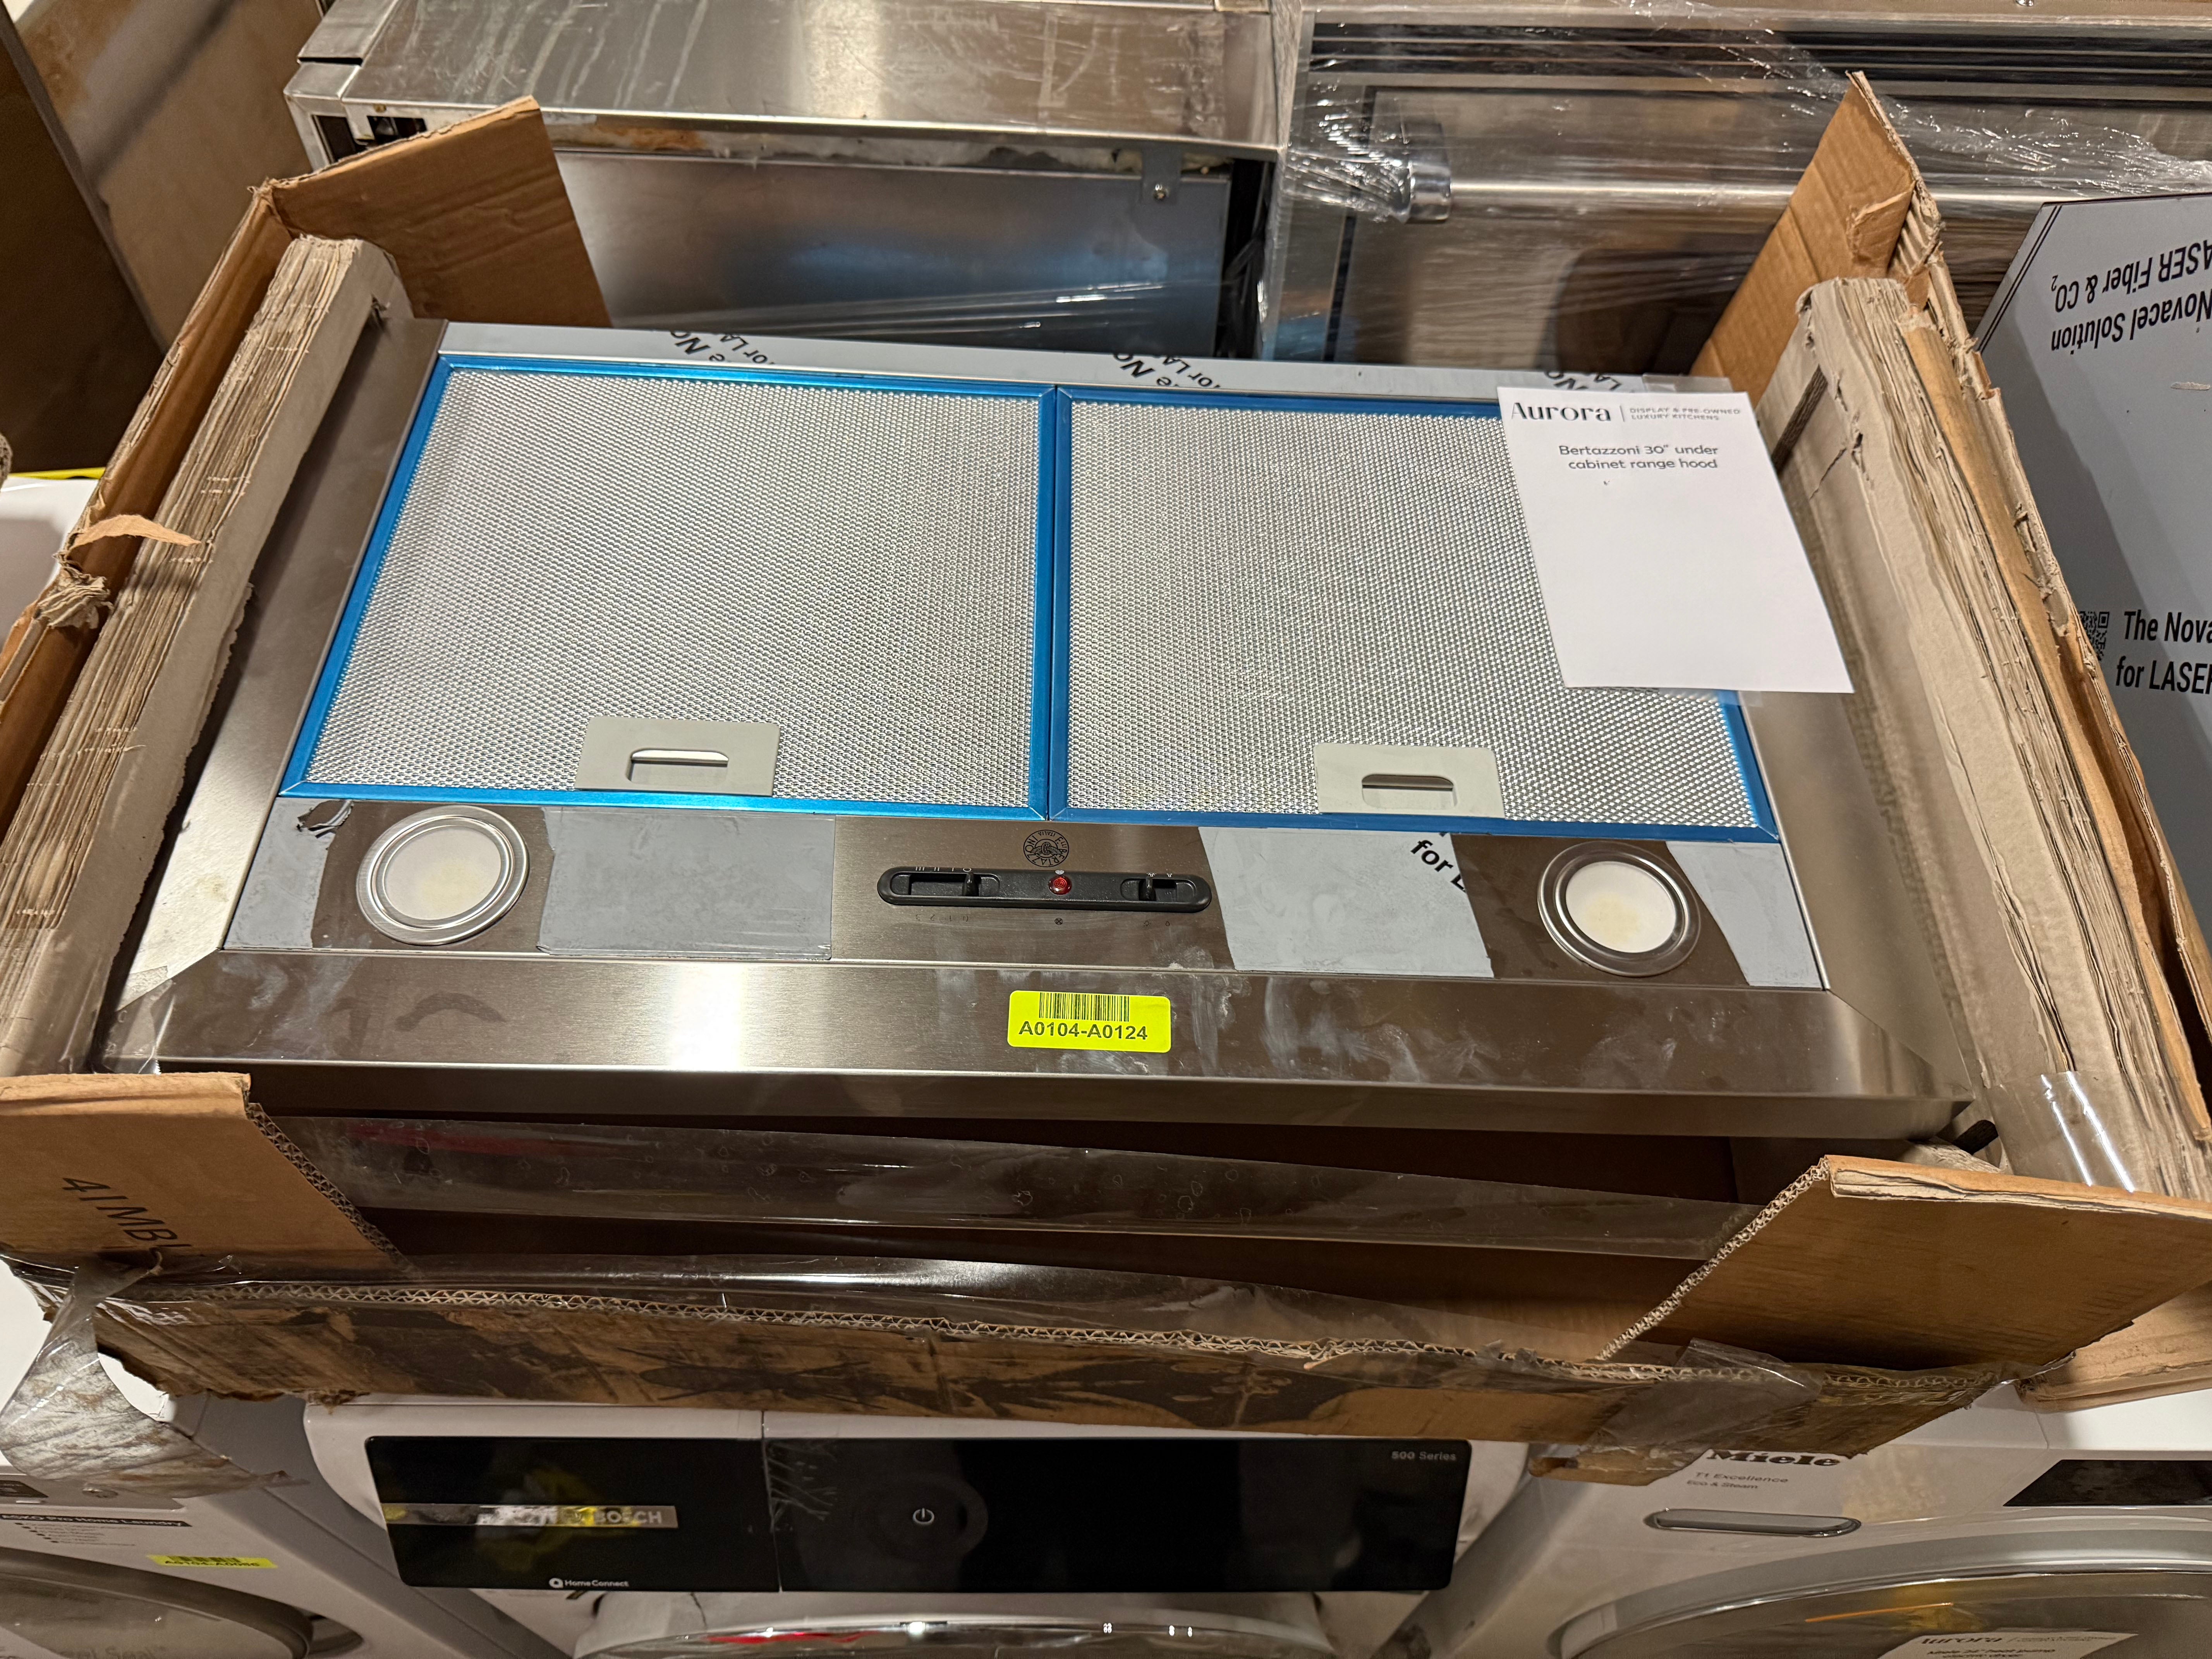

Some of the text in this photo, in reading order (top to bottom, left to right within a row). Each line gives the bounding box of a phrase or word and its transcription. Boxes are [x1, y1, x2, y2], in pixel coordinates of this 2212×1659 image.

[2102, 257, 2153, 294] Fiber
[2085, 275, 2098, 303] &
[2051, 289, 2212, 355] Novacel Solution
[1511, 402, 1611, 421] Aurora
[1559, 445, 1640, 455] Bertazzoni
[1675, 445, 1718, 455] under
[1568, 459, 1718, 469] cabinet range hood
[2124, 609, 2158, 641] The
[2116, 655, 2145, 687] for
[1410, 840, 1453, 872] for
[1018, 1021, 1147, 1040] A0104-A0124
[1392, 1451, 1456, 1460] 500 Series
[1706, 1449, 1840, 1466] Miele
[1714, 1474, 1788, 1483] Excellence
[594, 1511, 663, 1523] BOSCH
